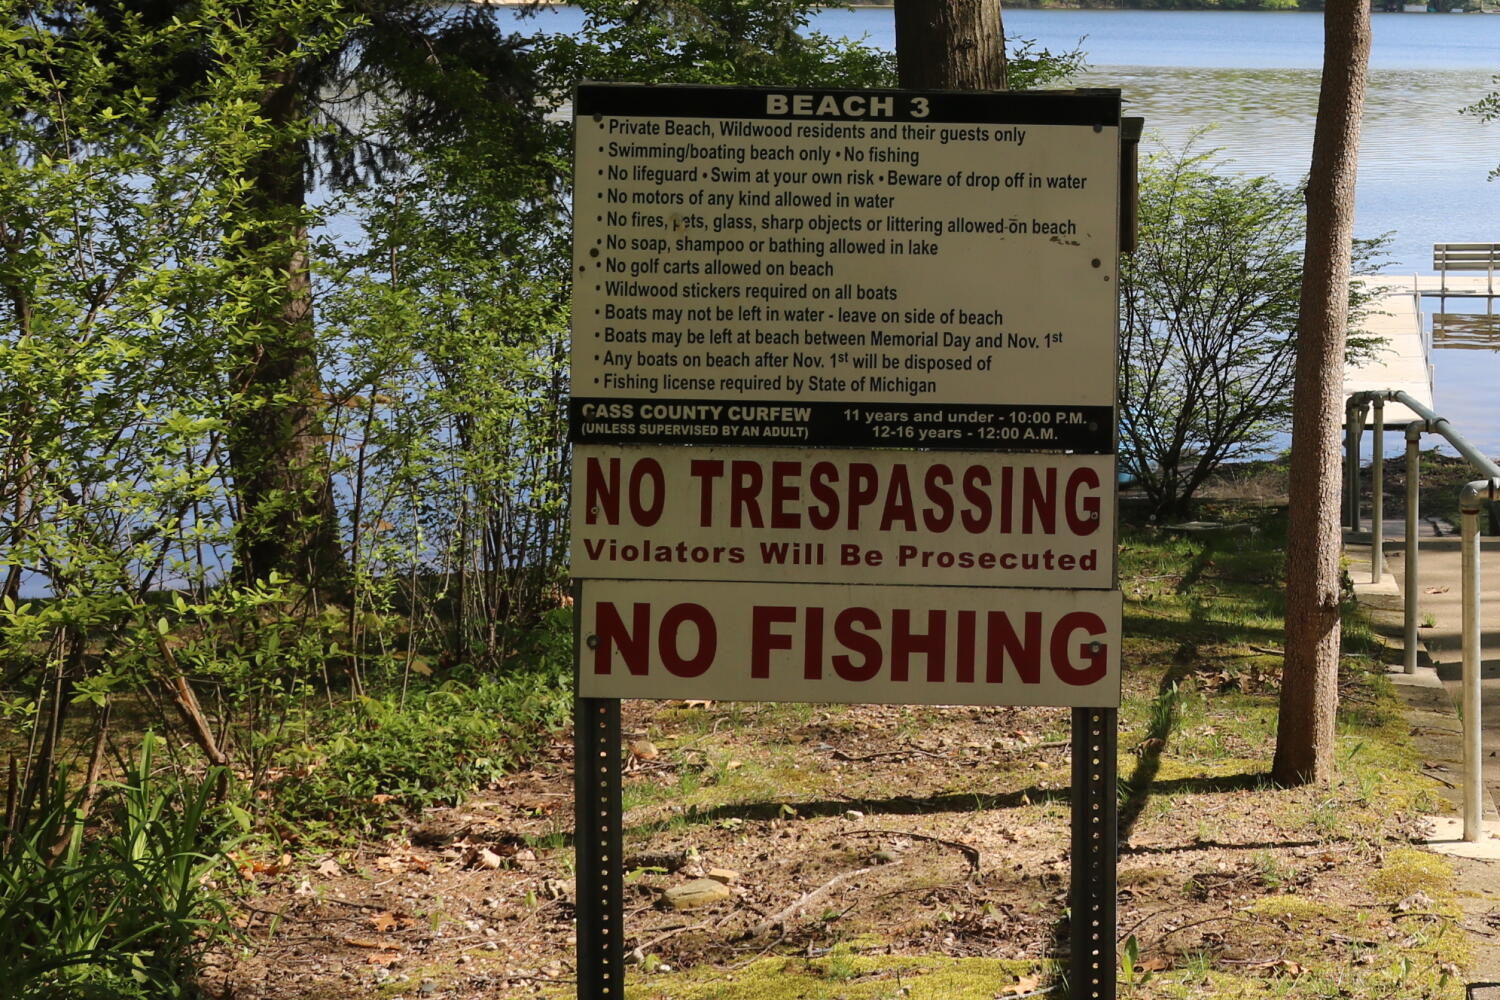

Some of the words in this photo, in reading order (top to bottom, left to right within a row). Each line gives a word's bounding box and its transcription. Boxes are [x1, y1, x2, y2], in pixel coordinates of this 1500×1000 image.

[766, 94, 894, 117] BEACH
[910, 98, 930, 117] 3
[609, 119, 660, 135] Private
[665, 120, 714, 138] Beach,
[720, 121, 792, 137] Wildwood
[797, 122, 865, 139] residents
[871, 125, 897, 139] and
[902, 125, 936, 140] their
[941, 127, 989, 144] guests
[995, 128, 1026, 146] only
[609, 143, 745, 163] Swimming/boating
[750, 146, 794, 161] beach
[800, 147, 830, 164] only
[844, 147, 864, 161] No
[869, 147, 919, 166] fishing
[608, 165, 627, 181] No
[633, 166, 697, 184] lifeguard
[711, 168, 750, 182] Swim
[756, 169, 769, 183] at
[774, 171, 807, 187] your
[812, 171, 841, 184] own
[847, 170, 873, 185] risk
[888, 170, 942, 186] Beware
[947, 171, 961, 187] of
[966, 172, 999, 190] drop
[1005, 173, 1024, 187] off
[1029, 173, 1041, 188] in
[1047, 175, 1087, 189] water
[607, 189, 627, 204] No
[633, 190, 683, 204] motors
[689, 190, 703, 205] of
[708, 193, 734, 209] any
[739, 191, 770, 206] kind
[775, 192, 831, 206] allowed
[836, 193, 849, 207] in
[854, 195, 894, 208] water
[607, 212, 626, 227] No
[632, 212, 667, 229] fires,
[713, 214, 756, 231] glass,
[762, 214, 803, 233] sharp
[808, 215, 861, 233] objects
[867, 218, 882, 231] or
[887, 217, 942, 234] littering
[948, 218, 1004, 233] allowed
[1033, 220, 1076, 234] beach
[607, 235, 626, 250] No
[631, 238, 670, 254] soap,
[676, 237, 744, 256] shampoo
[750, 240, 764, 252] or
[769, 236, 824, 257] bathing
[829, 238, 884, 255] allowed
[891, 239, 903, 255] in
[909, 240, 938, 255] lake
[606, 258, 626, 272] No
[631, 258, 659, 276] golf
[664, 260, 699, 274] carts
[704, 260, 760, 275] allowed
[766, 263, 784, 275] on
[790, 261, 833, 276] beach
[605, 281, 677, 297] Wildwood
[683, 282, 740, 298] stickers
[746, 283, 807, 301] required
[812, 286, 830, 299] on
[835, 284, 851, 299] all
[857, 285, 897, 300] boats
[605, 304, 647, 320] Boats
[652, 307, 682, 324] may
[688, 307, 711, 321] not
[716, 306, 733, 321] be
[738, 306, 761, 321] left
[766, 307, 779, 321] in
[784, 309, 824, 322] water
[839, 307, 876, 323] leave
[882, 310, 899, 323] on
[905, 309, 935, 324] side
[940, 309, 955, 324] of
[959, 310, 1002, 325] beach
[605, 328, 647, 343] Boats
[652, 331, 682, 347] may
[687, 329, 704, 344] be
[710, 329, 732, 344] left
[737, 331, 750, 344] at
[756, 329, 799, 345] beach
[805, 330, 865, 345] between
[871, 331, 938, 347] Memorial
[943, 332, 970, 351] Day
[976, 333, 1002, 348] and
[1008, 334, 1039, 348] Nov.
[604, 351, 632, 370] Any
[637, 351, 677, 366] boats
[683, 354, 701, 367] on
[706, 352, 749, 367] beach
[755, 353, 788, 368] after
[793, 353, 824, 368] Nov.
[853, 354, 877, 369] will
[882, 354, 899, 369] be
[905, 355, 972, 373] disposed
[977, 356, 992, 370] of
[604, 374, 658, 393] Fishing
[664, 375, 715, 390] license
[720, 376, 781, 394] required
[787, 376, 803, 395] by
[808, 376, 845, 391] State
[851, 377, 865, 391] of
[870, 377, 936, 396] Michigan
[582, 404, 634, 419] CASS
[640, 405, 722, 420] COUNTY
[728, 407, 811, 422] CURFEW
[844, 410, 860, 421] 11
[865, 411, 908, 424] years
[914, 411, 942, 422] and
[948, 411, 994, 423] under
[1009, 412, 1050, 424] 10:00
[1056, 412, 1087, 424] P.M.
[581, 423, 635, 435] (UNLESS
[640, 425, 718, 436] SUPERVISED
[722, 426, 740, 436] BY
[742, 426, 759, 437] AN
[763, 426, 808, 439] ADULT)
[872, 426, 914, 438] 12-16
[919, 429, 962, 440] years
[978, 428, 1019, 440] 12:00
[1023, 428, 1058, 440] A.M.
[586, 457, 665, 527] NO
[690, 459, 1101, 537] TRESPASSING
[584, 539, 745, 564] Violators
[760, 542, 824, 566] Will
[840, 544, 883, 567] Be
[899, 545, 1098, 572] Prosecuted
[594, 601, 718, 678] NO
[750, 605, 1108, 686] FISHING
